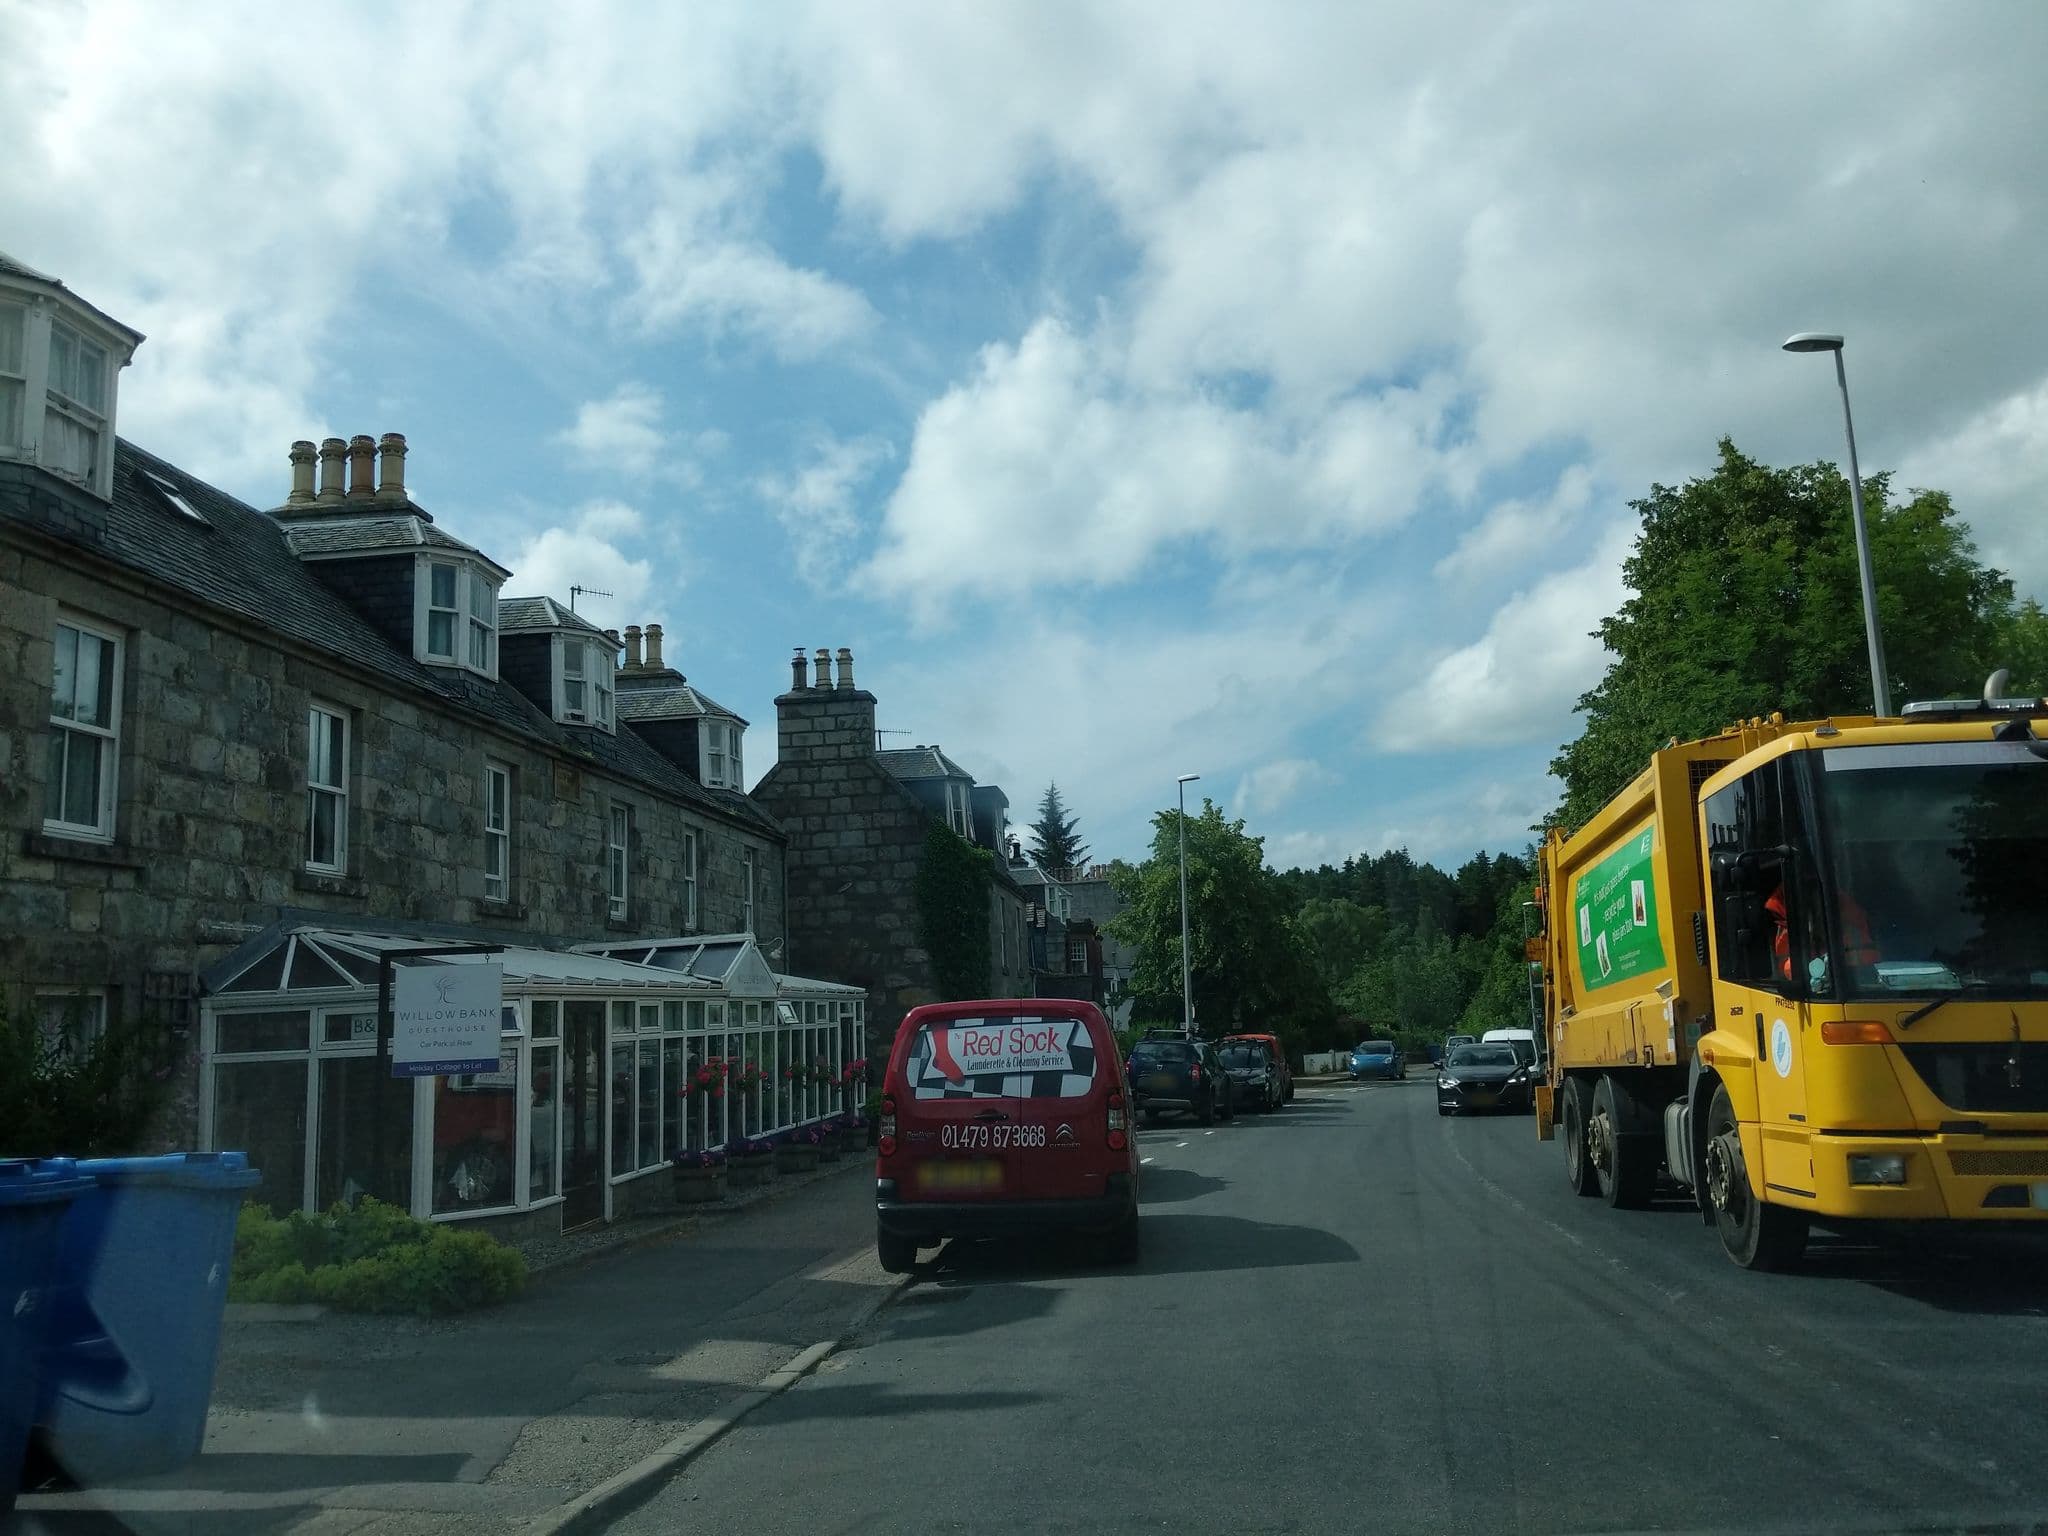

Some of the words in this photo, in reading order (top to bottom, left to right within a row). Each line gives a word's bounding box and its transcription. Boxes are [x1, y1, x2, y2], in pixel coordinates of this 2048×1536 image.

[420, 1040, 431, 1048] Car
[433, 1040, 447, 1049] Park
[963, 1029, 1004, 1056] Red
[1009, 1026, 1063, 1054] Sock
[409, 1064, 434, 1073] Holiday
[435, 1063, 462, 1072] Cottage
[471, 1061, 482, 1069] Let
[967, 1058, 1005, 1071] Launderette
[1006, 1057, 1012, 1068] &
[1012, 1056, 1040, 1069] Cleaning
[1041, 1054, 1064, 1067] Service
[941, 1124, 989, 1149] 01479
[993, 1125, 1046, 1148] 873668
